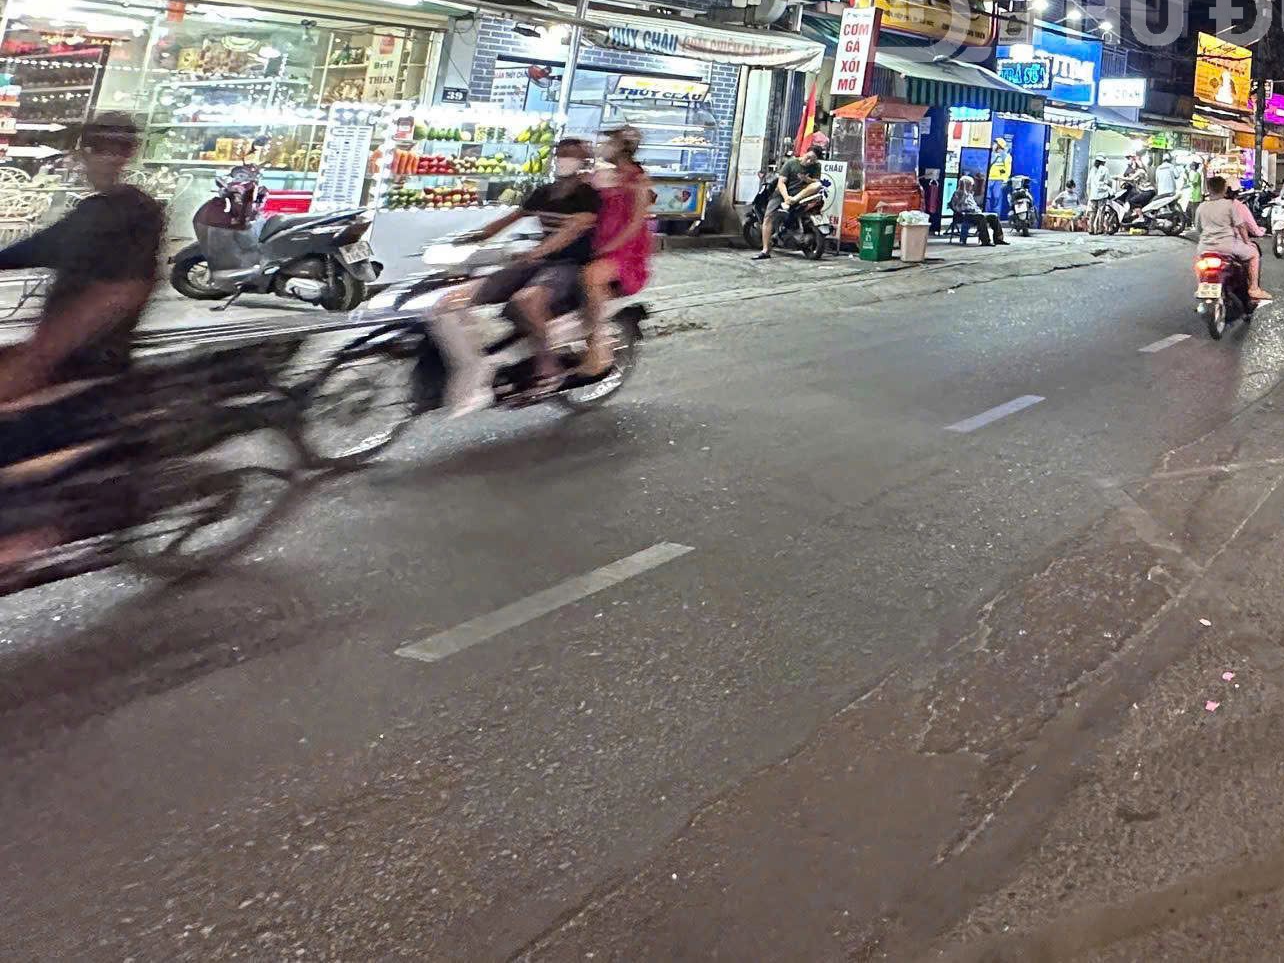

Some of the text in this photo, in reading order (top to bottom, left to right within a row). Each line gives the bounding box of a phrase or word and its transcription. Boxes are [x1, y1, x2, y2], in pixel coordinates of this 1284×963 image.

[842, 23, 870, 37] CƠM
[643, 28, 680, 52] CHÂU
[840, 57, 861, 74] XỐI
[445, 91, 464, 101] 39
